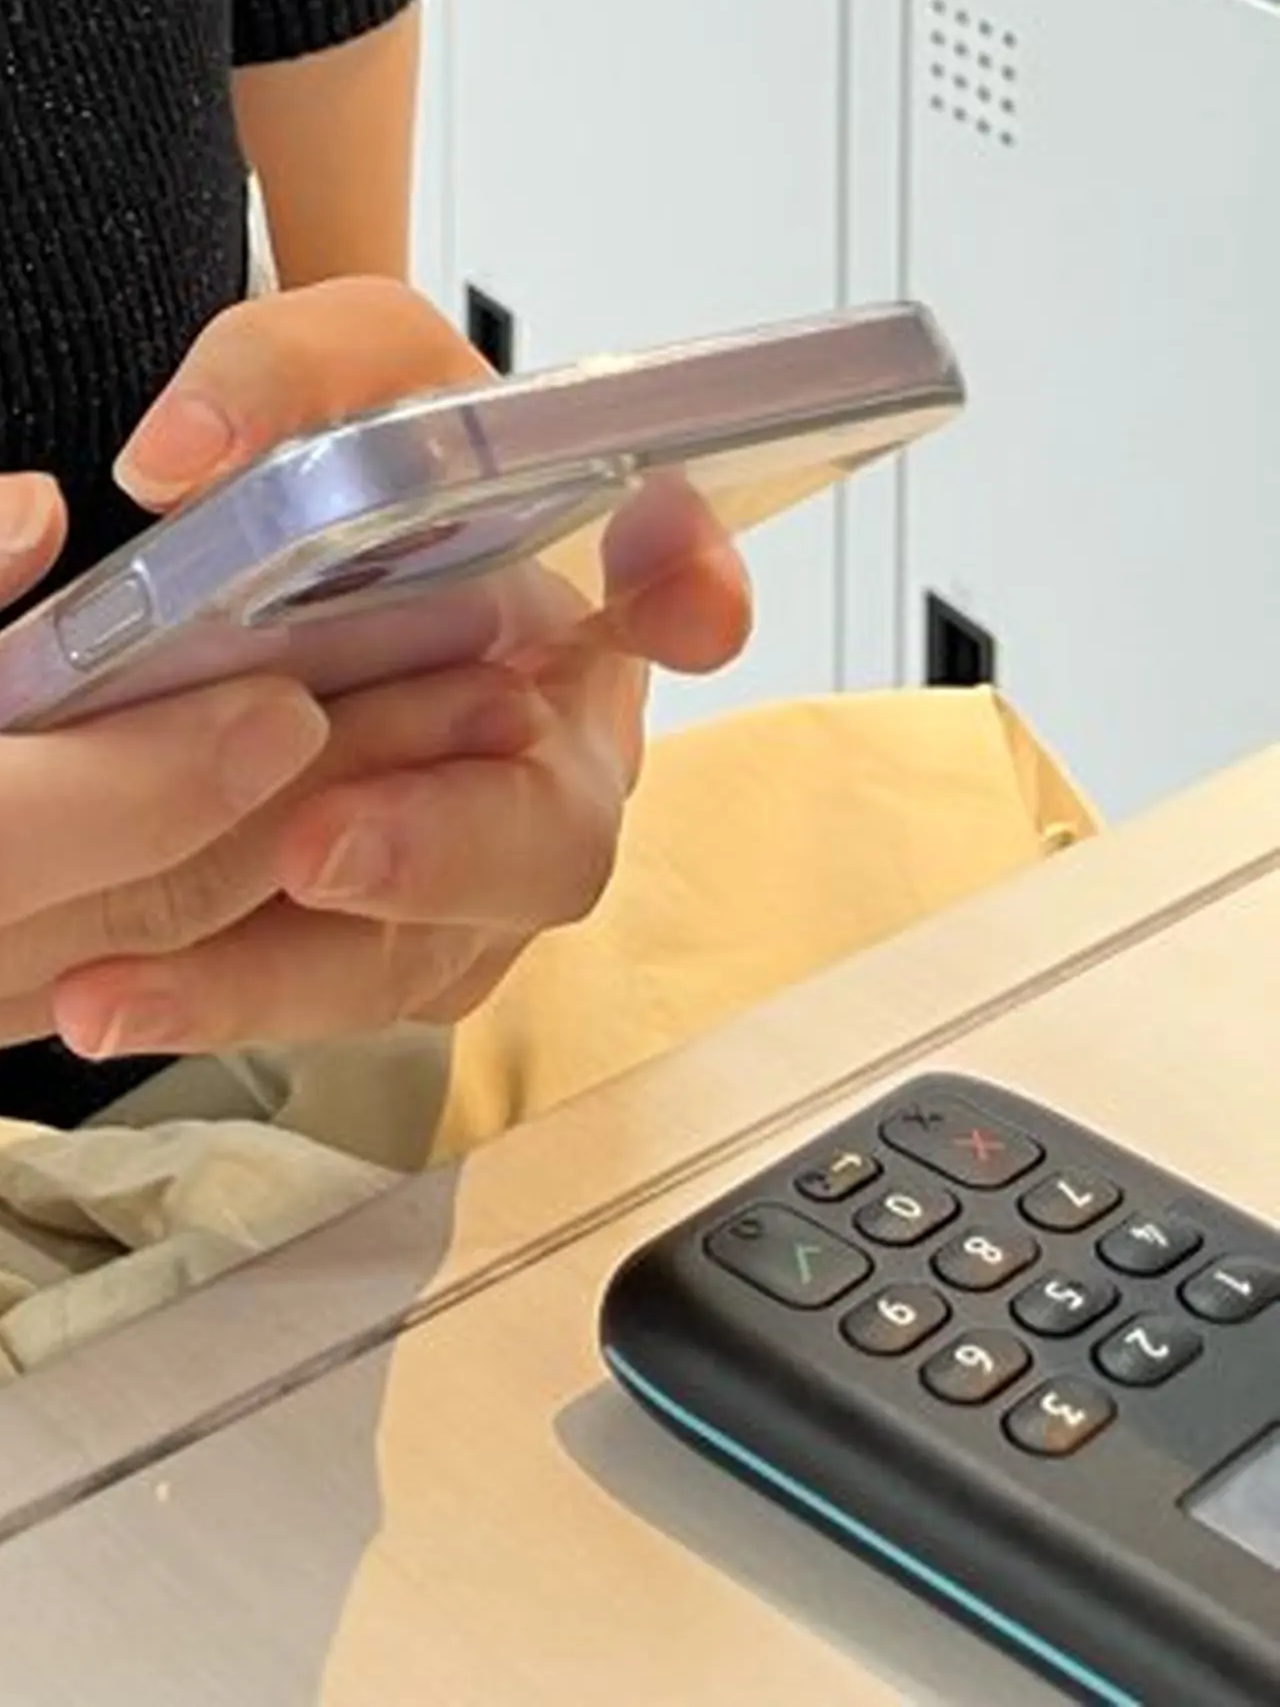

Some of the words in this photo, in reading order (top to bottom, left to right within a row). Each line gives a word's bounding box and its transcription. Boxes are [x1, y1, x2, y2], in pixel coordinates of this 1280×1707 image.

[885, 1194, 923, 1220] 0
[1057, 1180, 1093, 1208] 7
[963, 1236, 1005, 1265] 8
[1044, 1280, 1084, 1310] 5
[1214, 1270, 1252, 1296] 1
[878, 1299, 917, 1326] 9
[1124, 1327, 1169, 1358] 2
[954, 1344, 994, 1375] 6
[1041, 1392, 1086, 1427] 3
